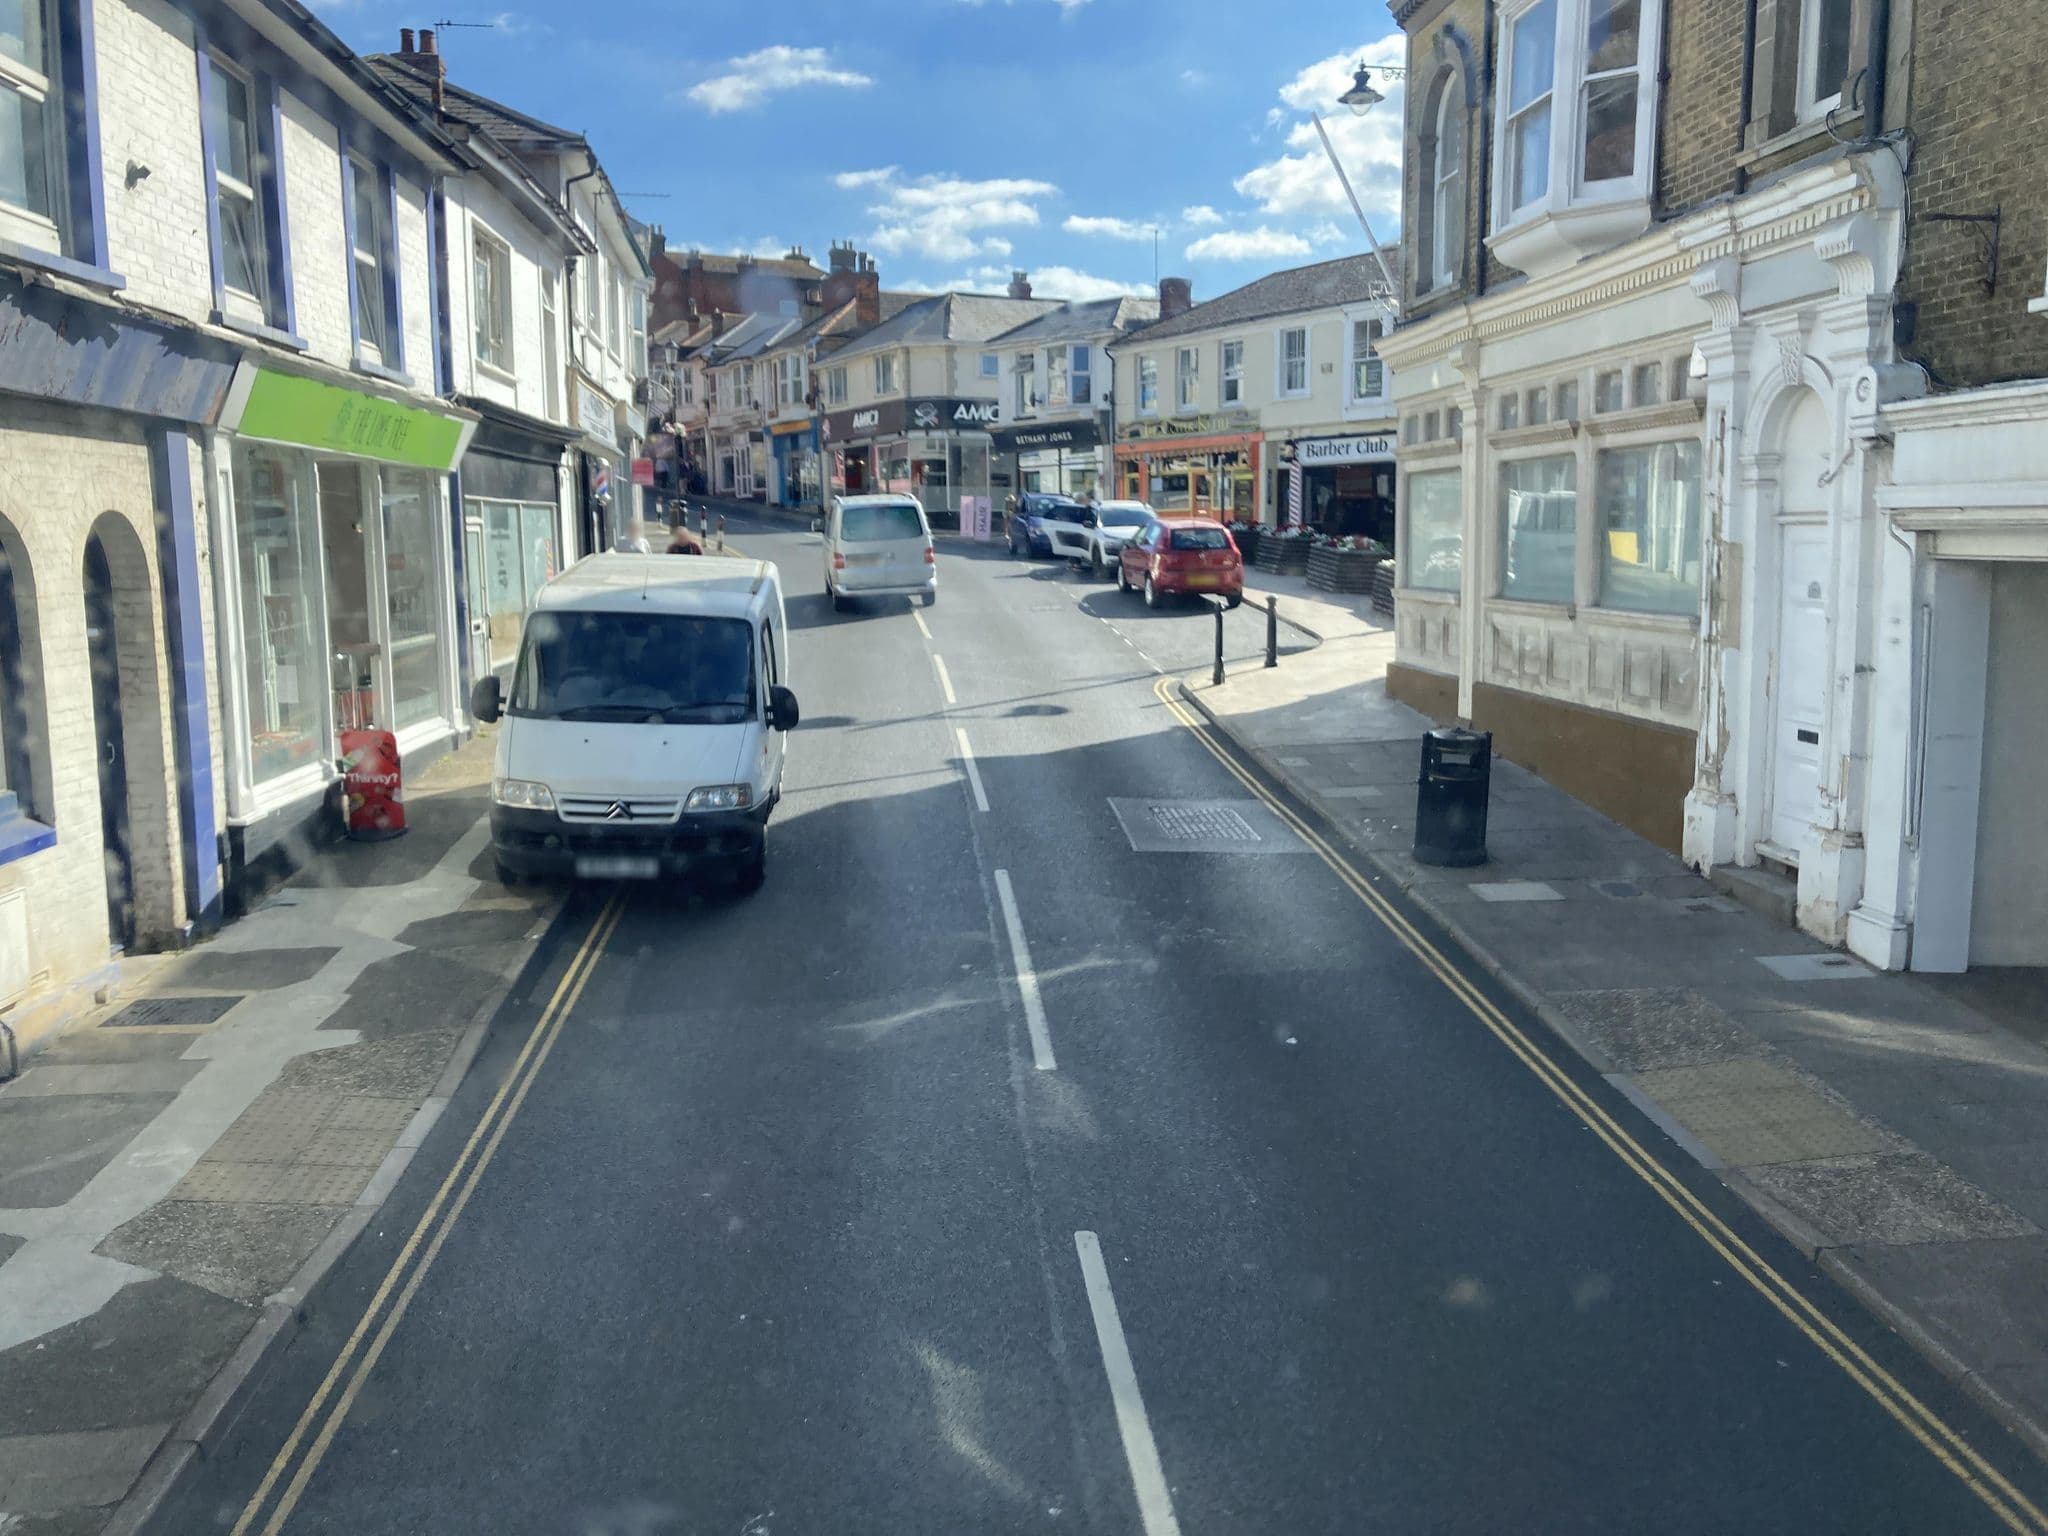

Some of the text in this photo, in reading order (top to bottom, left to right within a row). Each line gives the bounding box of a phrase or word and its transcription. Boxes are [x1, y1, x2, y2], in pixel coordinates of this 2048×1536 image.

[853, 409, 879, 427] AMICI
[953, 402, 999, 422] AMIC
[1016, 431, 1073, 445] BETHANY JONES
[1306, 437, 1389, 458] Barber Club
[349, 772, 398, 784] Thirsty?
